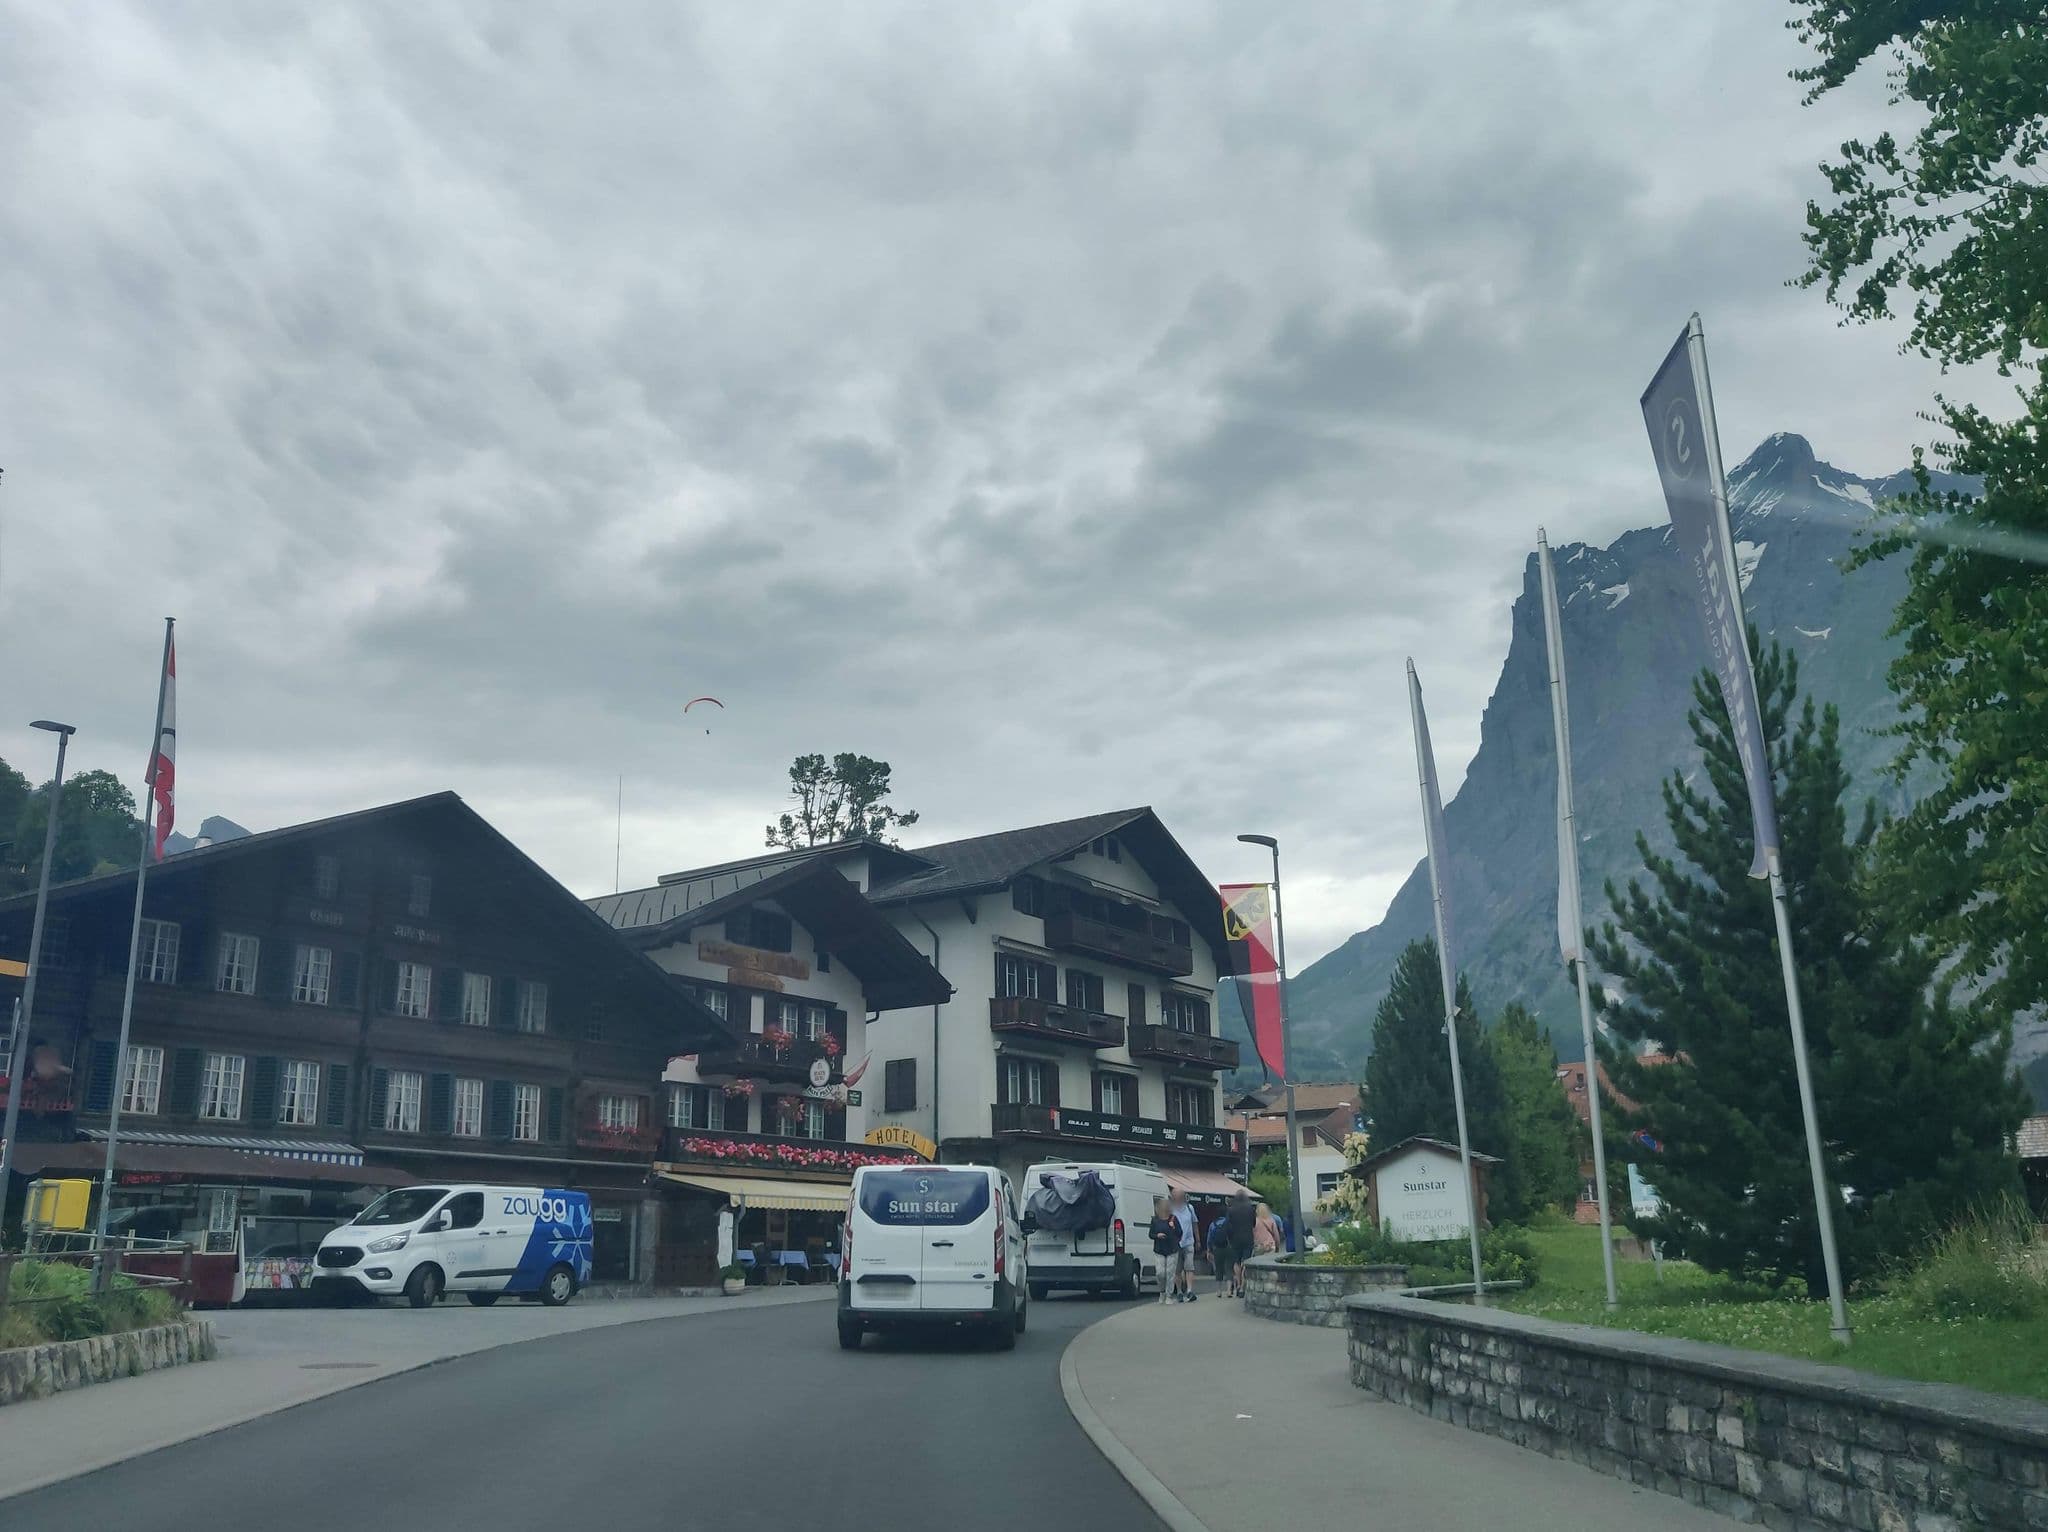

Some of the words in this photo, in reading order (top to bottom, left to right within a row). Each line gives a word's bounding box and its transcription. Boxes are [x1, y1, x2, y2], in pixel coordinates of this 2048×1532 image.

[876, 1128, 917, 1148] HOTEL
[1403, 1181, 1447, 1192] Sunstar
[503, 1197, 567, 1223] zaugg
[1402, 1208, 1452, 1220] HERZLICH
